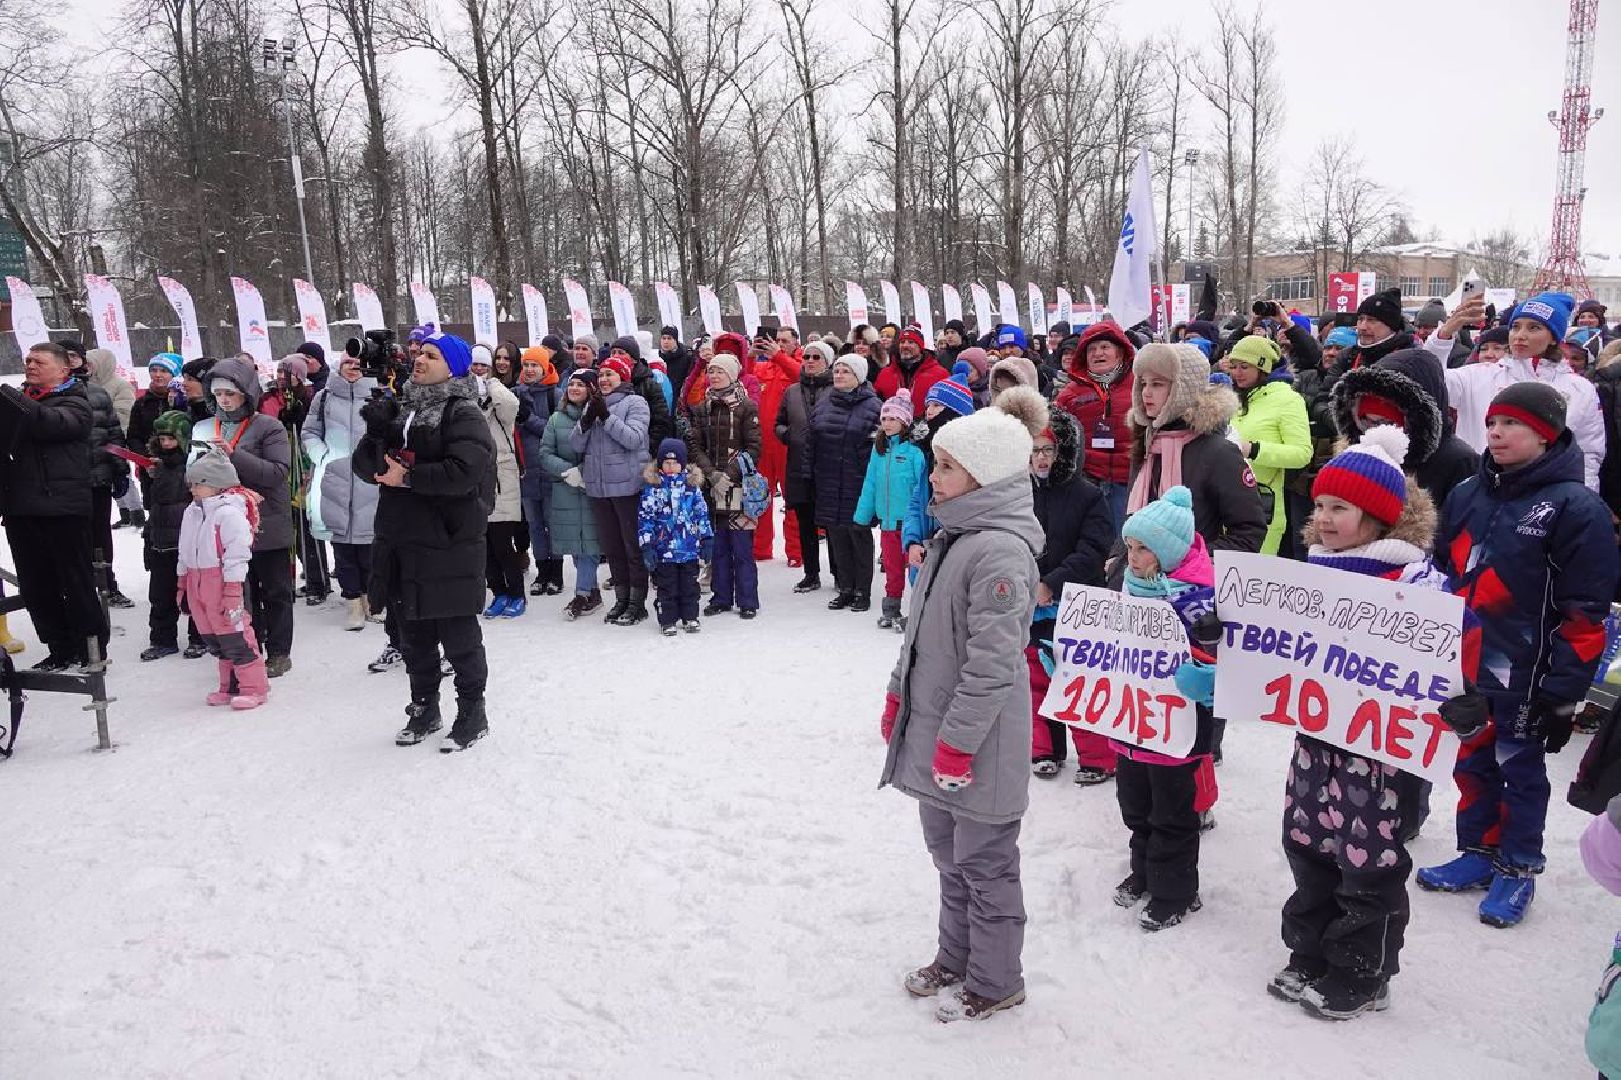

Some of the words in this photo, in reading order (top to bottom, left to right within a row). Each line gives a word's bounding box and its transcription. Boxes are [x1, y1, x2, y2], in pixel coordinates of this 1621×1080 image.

[1057, 637, 1120, 672] ТВОЕЙ
[1218, 566, 1326, 620] ЛЕГКОВ,
[1328, 597, 1461, 662] ПРИВЕТ,
[1219, 621, 1318, 668] ТВОЕЙ
[1323, 644, 1451, 702] ПОБЕДЕ
[1053, 675, 1111, 725] 10
[1112, 683, 1187, 745] ЛЕТ
[1260, 673, 1329, 732] 10
[1345, 698, 1452, 769] ЛЕТ
